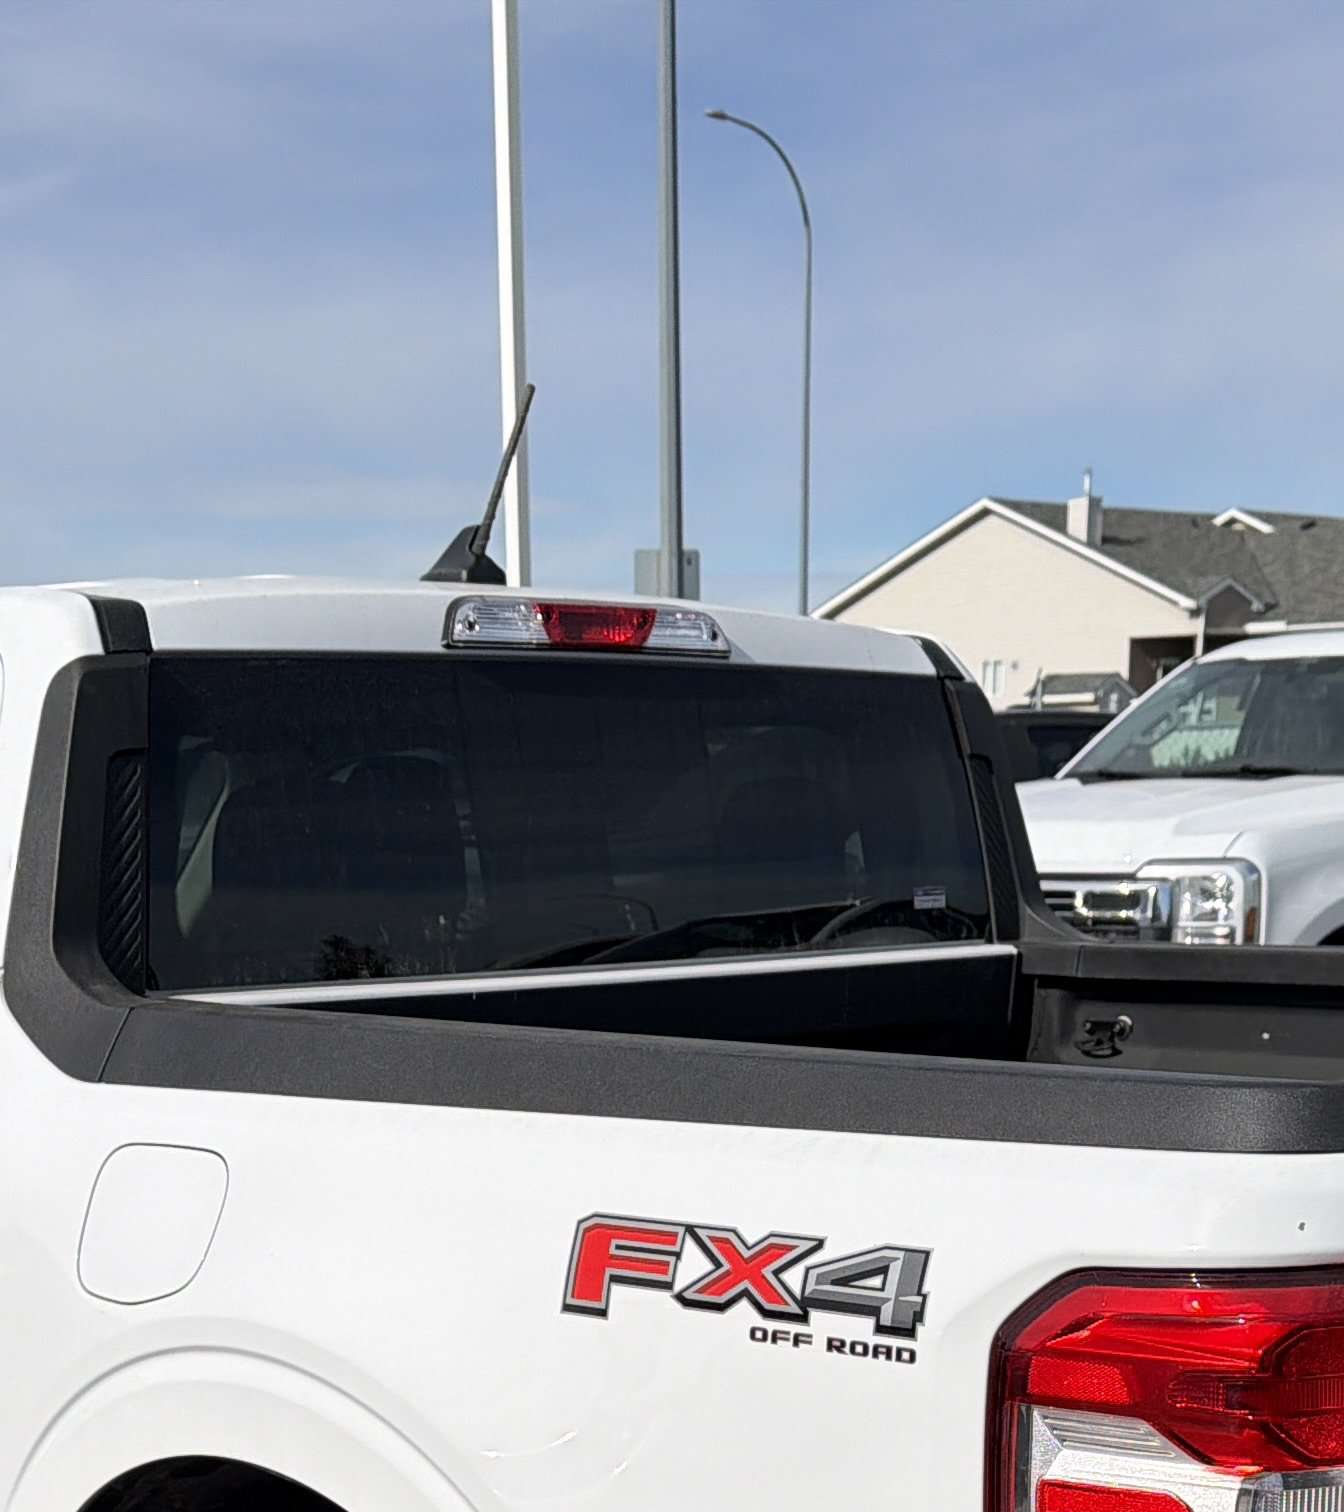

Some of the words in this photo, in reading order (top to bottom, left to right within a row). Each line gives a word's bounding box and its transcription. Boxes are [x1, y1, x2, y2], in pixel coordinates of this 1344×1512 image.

[559, 1211, 934, 1341] FX4
[749, 1325, 814, 1349] OFF
[825, 1336, 918, 1366] ROAD
